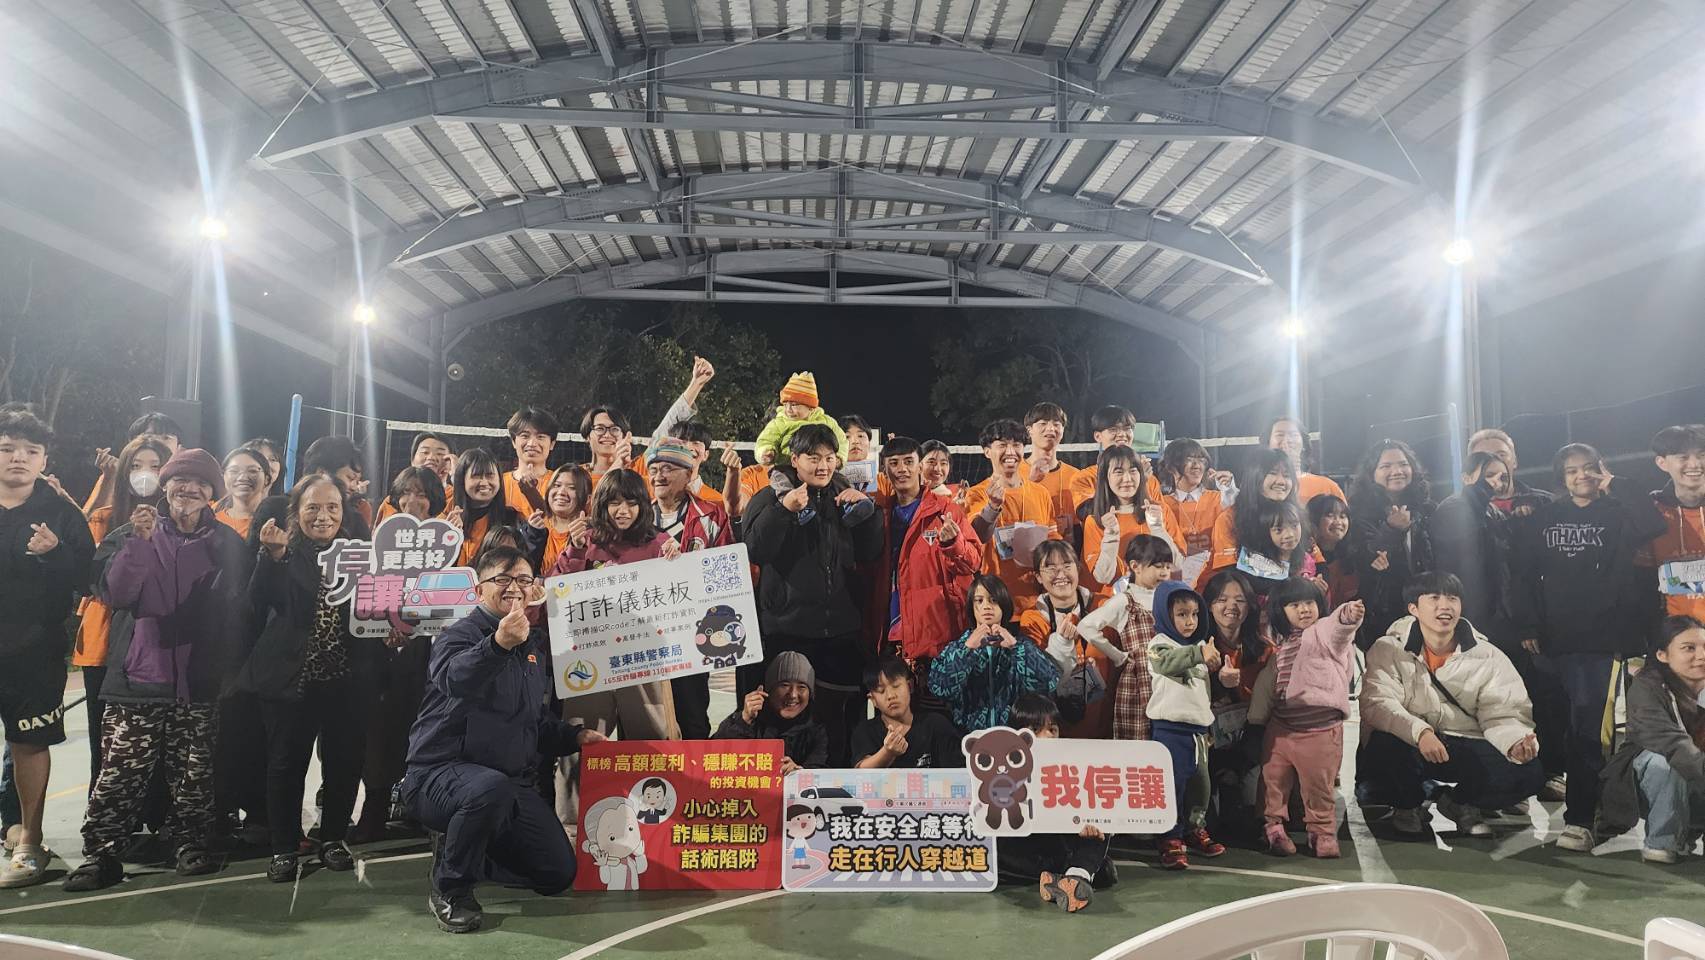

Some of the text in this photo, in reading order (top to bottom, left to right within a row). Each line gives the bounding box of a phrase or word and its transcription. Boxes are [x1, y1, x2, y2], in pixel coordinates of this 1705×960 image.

[394, 528, 436, 549] 世界
[1546, 527, 1605, 548] THANK
[382, 549, 446, 571] 更美好
[573, 571, 639, 591] 內政部警政署
[565, 581, 694, 623] 打詐儀錶板
[608, 643, 683, 669] 臺東縣警察局
[586, 753, 774, 772] 標榜 高額獲利、穩賺不賠
[1040, 765, 1167, 810] 我停讓
[683, 798, 758, 819] 小心掉入
[671, 824, 767, 844] 詐騙集團的
[681, 849, 758, 870] 話術陷阱
[830, 846, 988, 871] 走在行人穿越道
